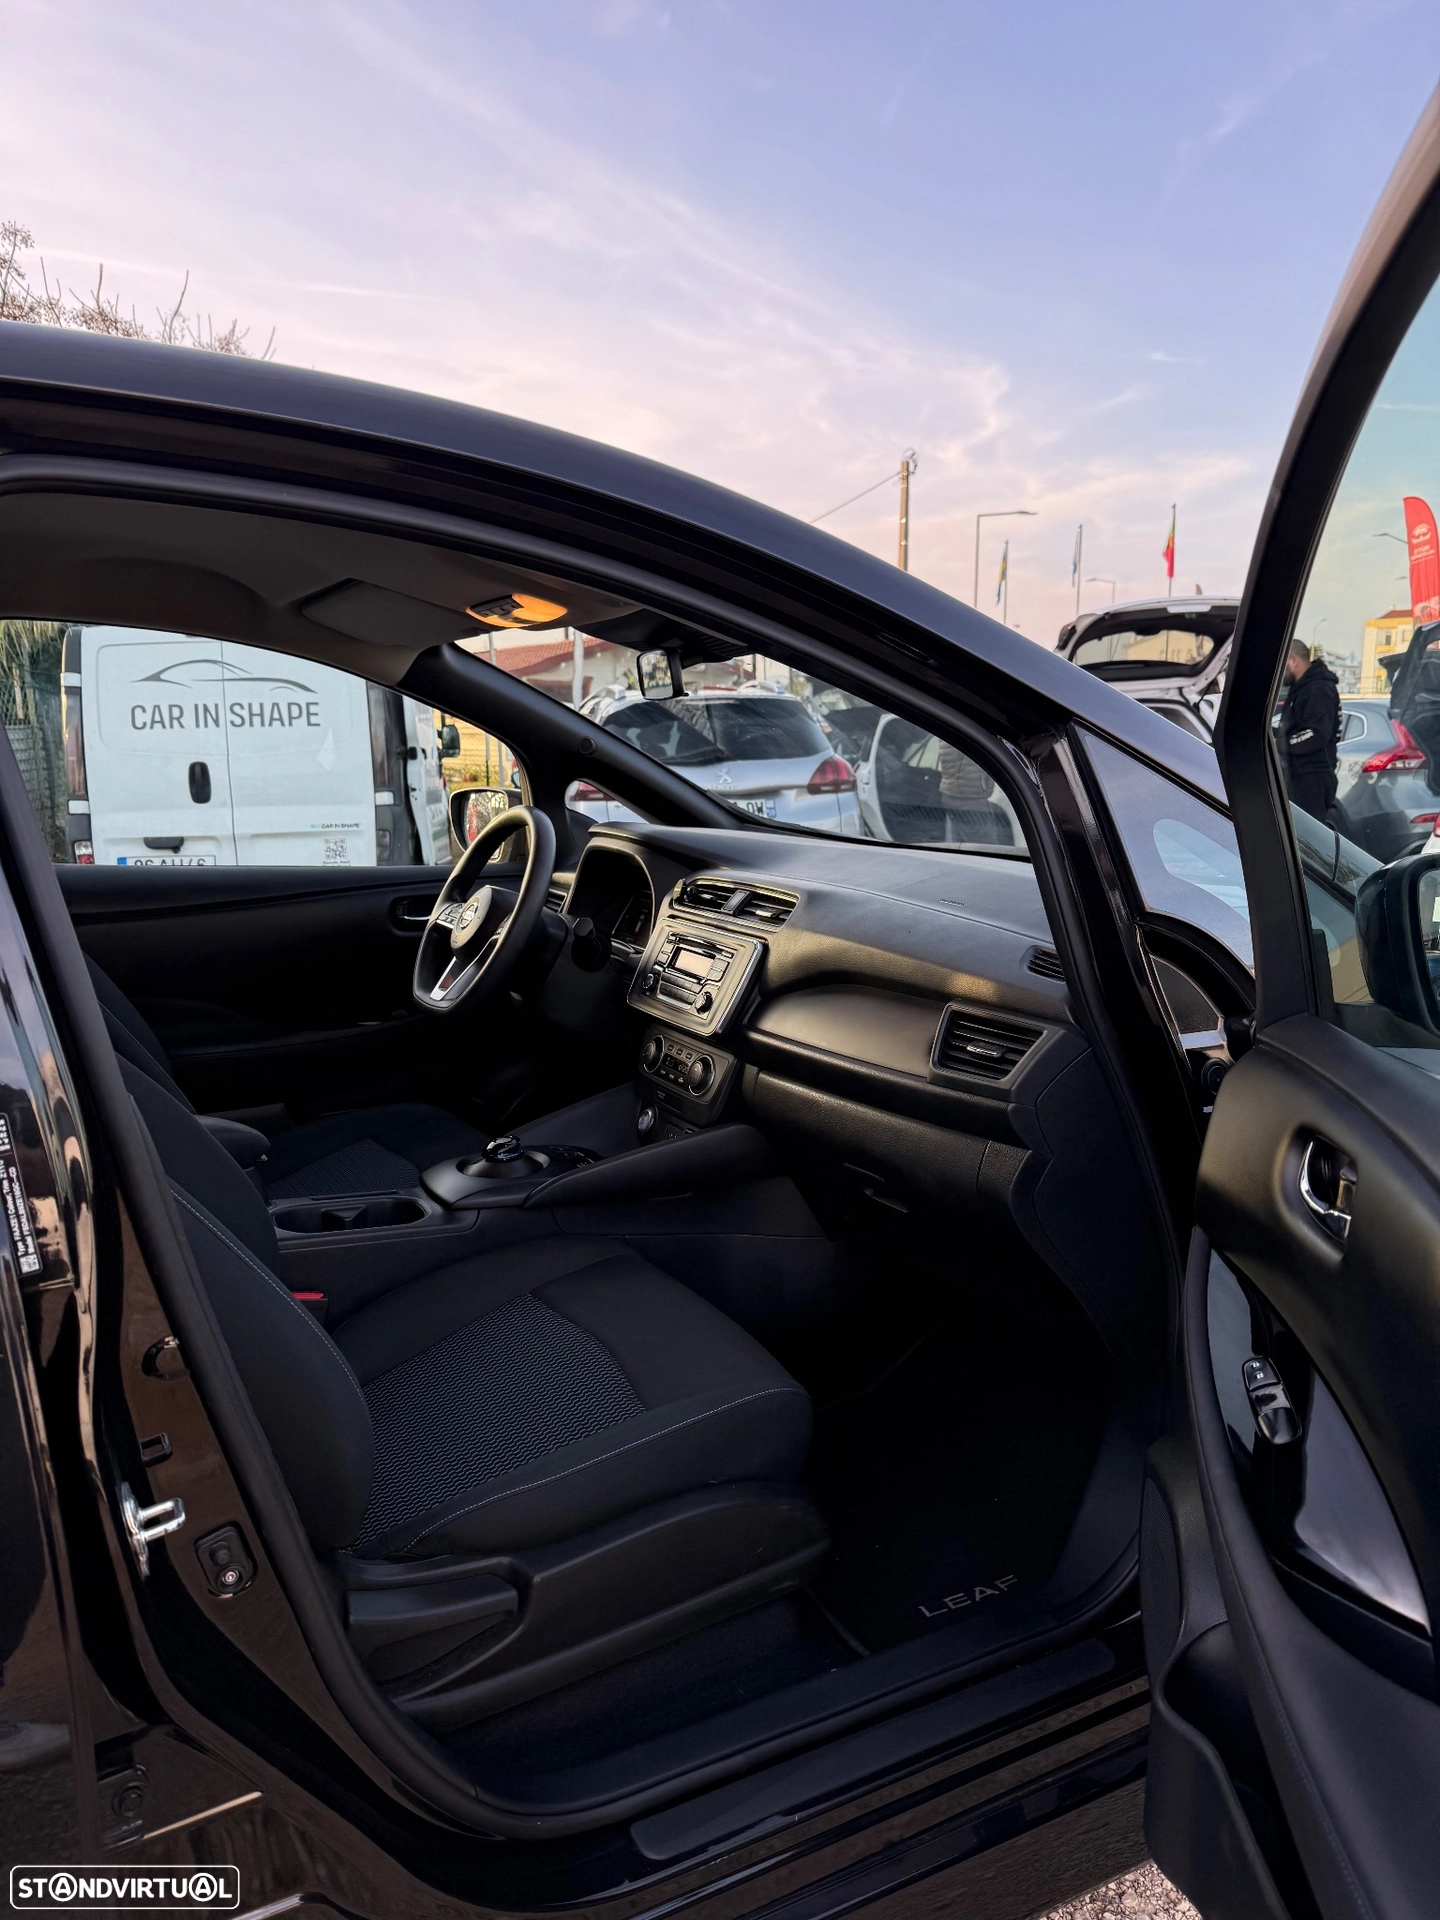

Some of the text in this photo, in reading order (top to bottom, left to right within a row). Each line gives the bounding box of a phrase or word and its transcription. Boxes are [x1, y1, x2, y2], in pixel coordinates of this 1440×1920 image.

[130, 701, 321, 731] CAR IN SHAPE
[917, 1574, 1018, 1617] LEAF
